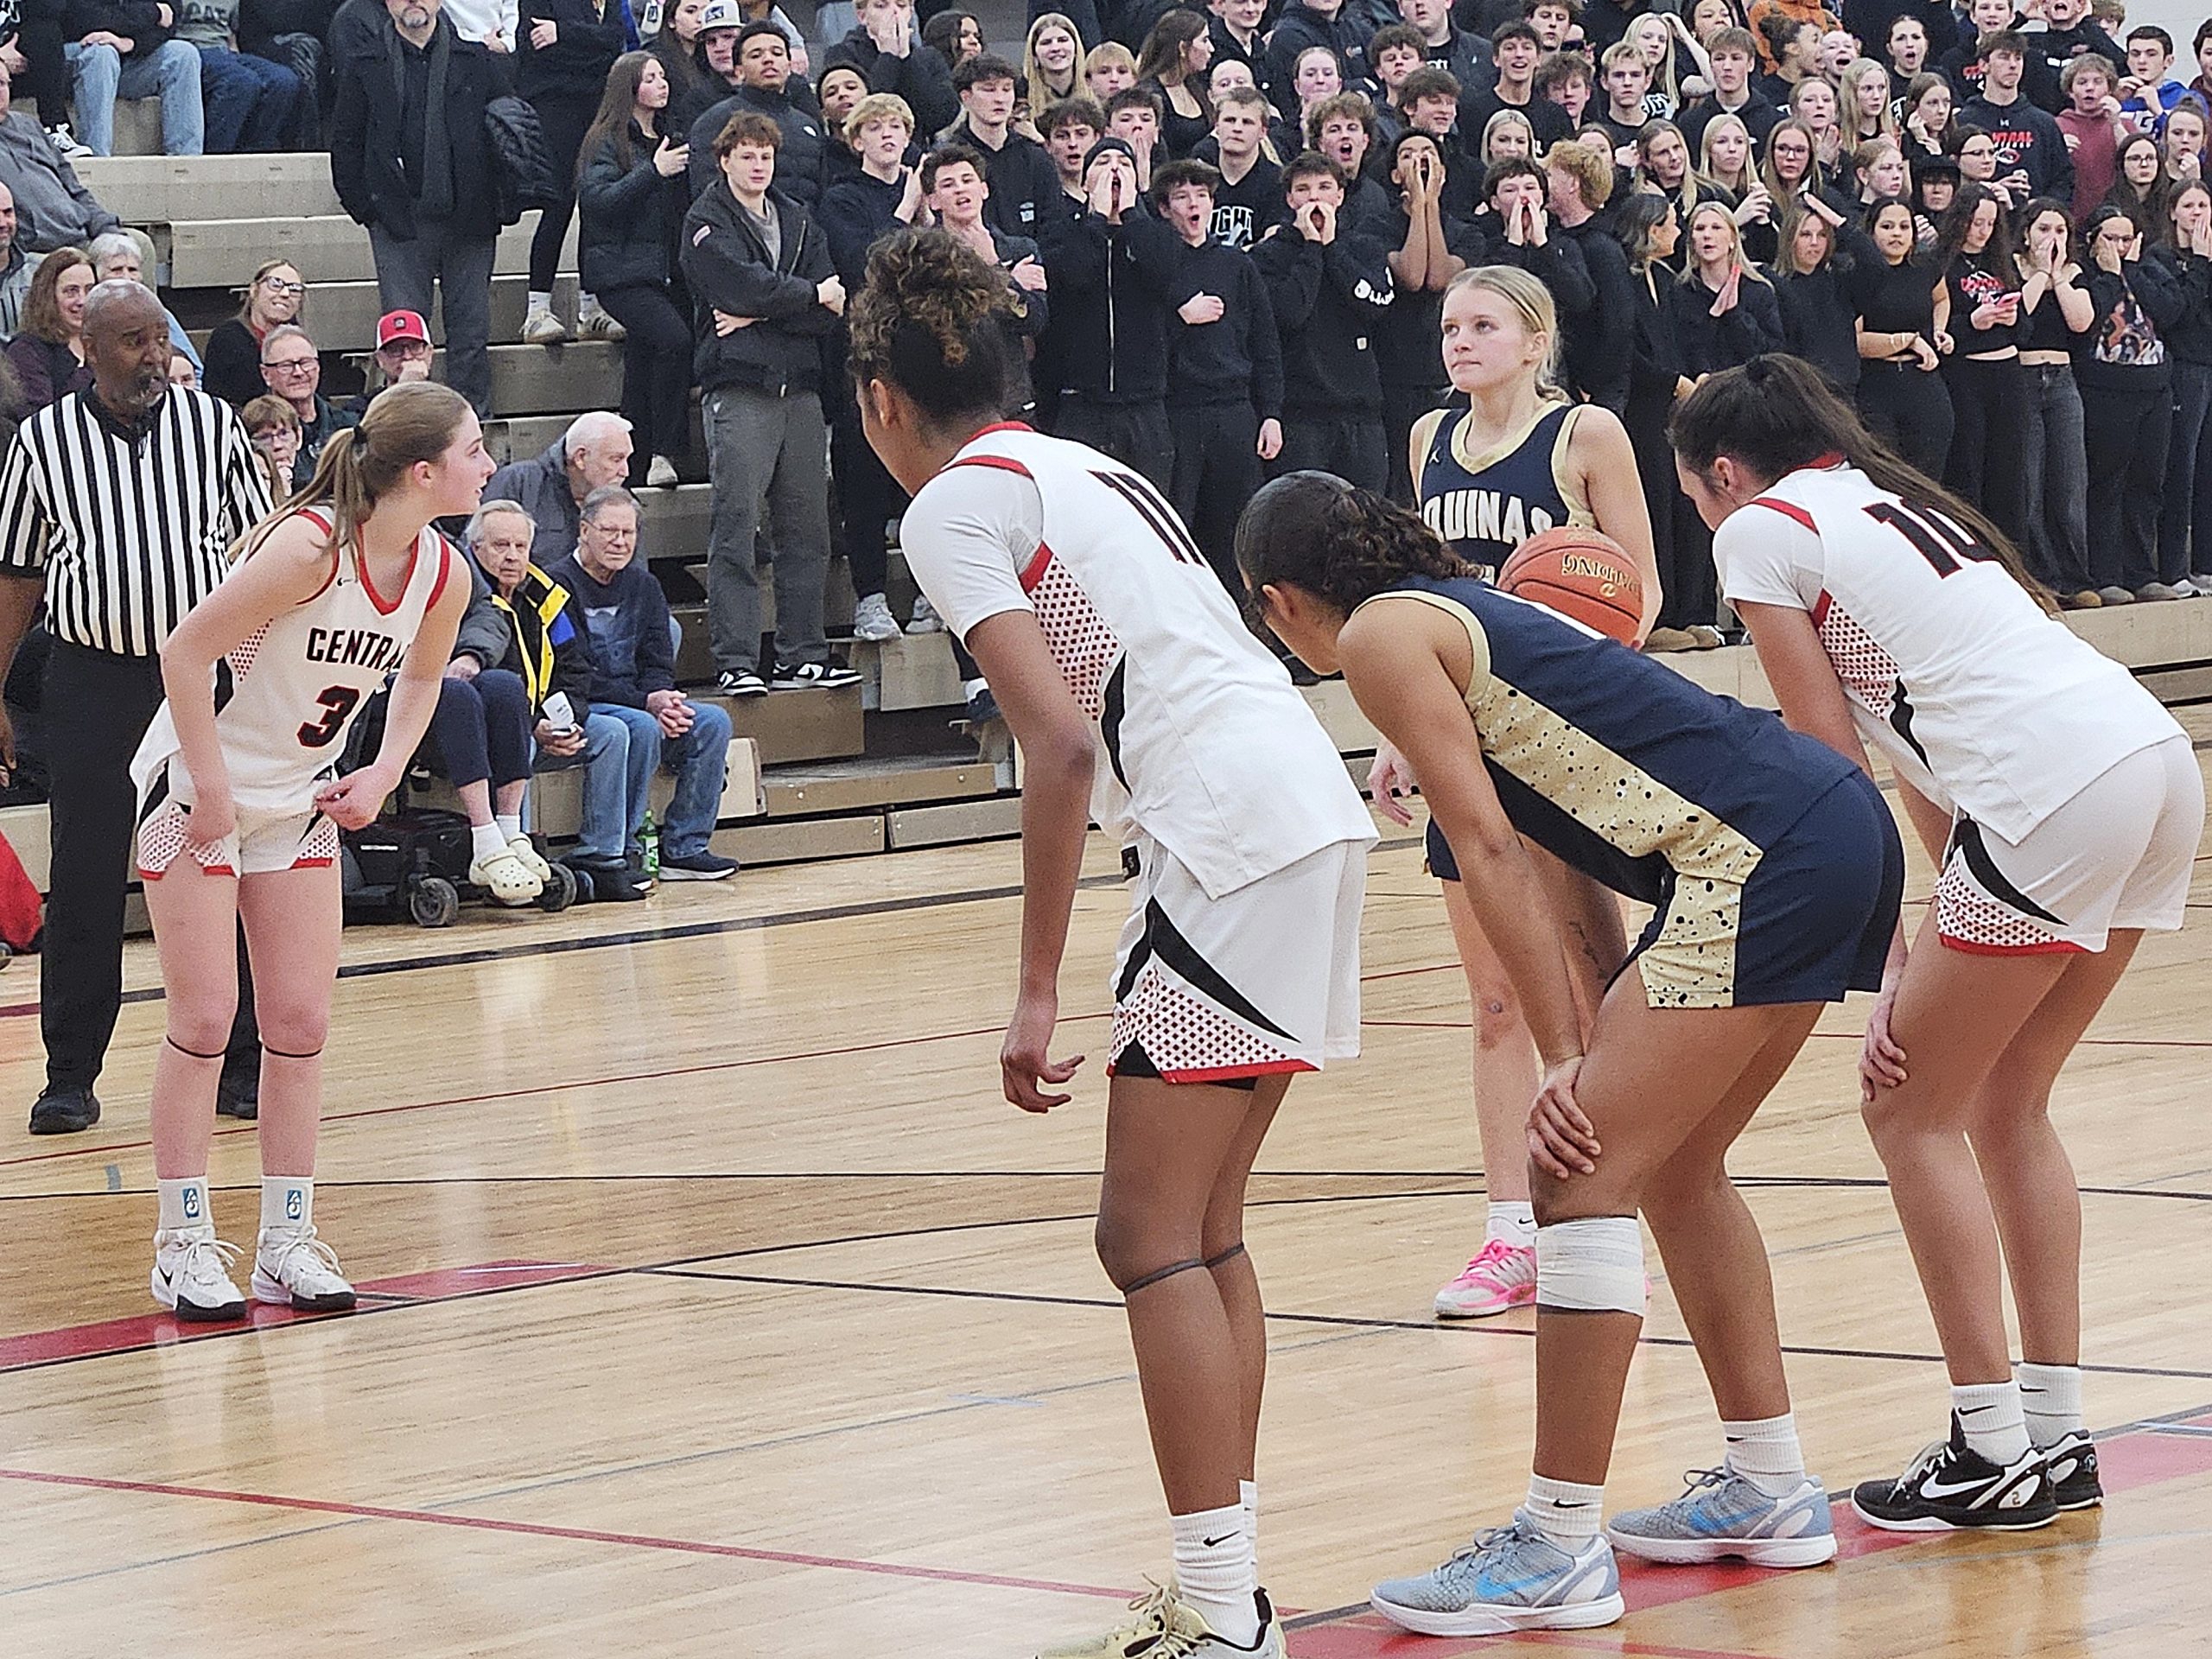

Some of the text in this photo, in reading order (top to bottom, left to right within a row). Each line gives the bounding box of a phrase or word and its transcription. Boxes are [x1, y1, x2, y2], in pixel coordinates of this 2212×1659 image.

[1085, 469, 1206, 568] 11
[1423, 489, 1553, 543] QUINAS
[296, 685, 360, 748] 3
